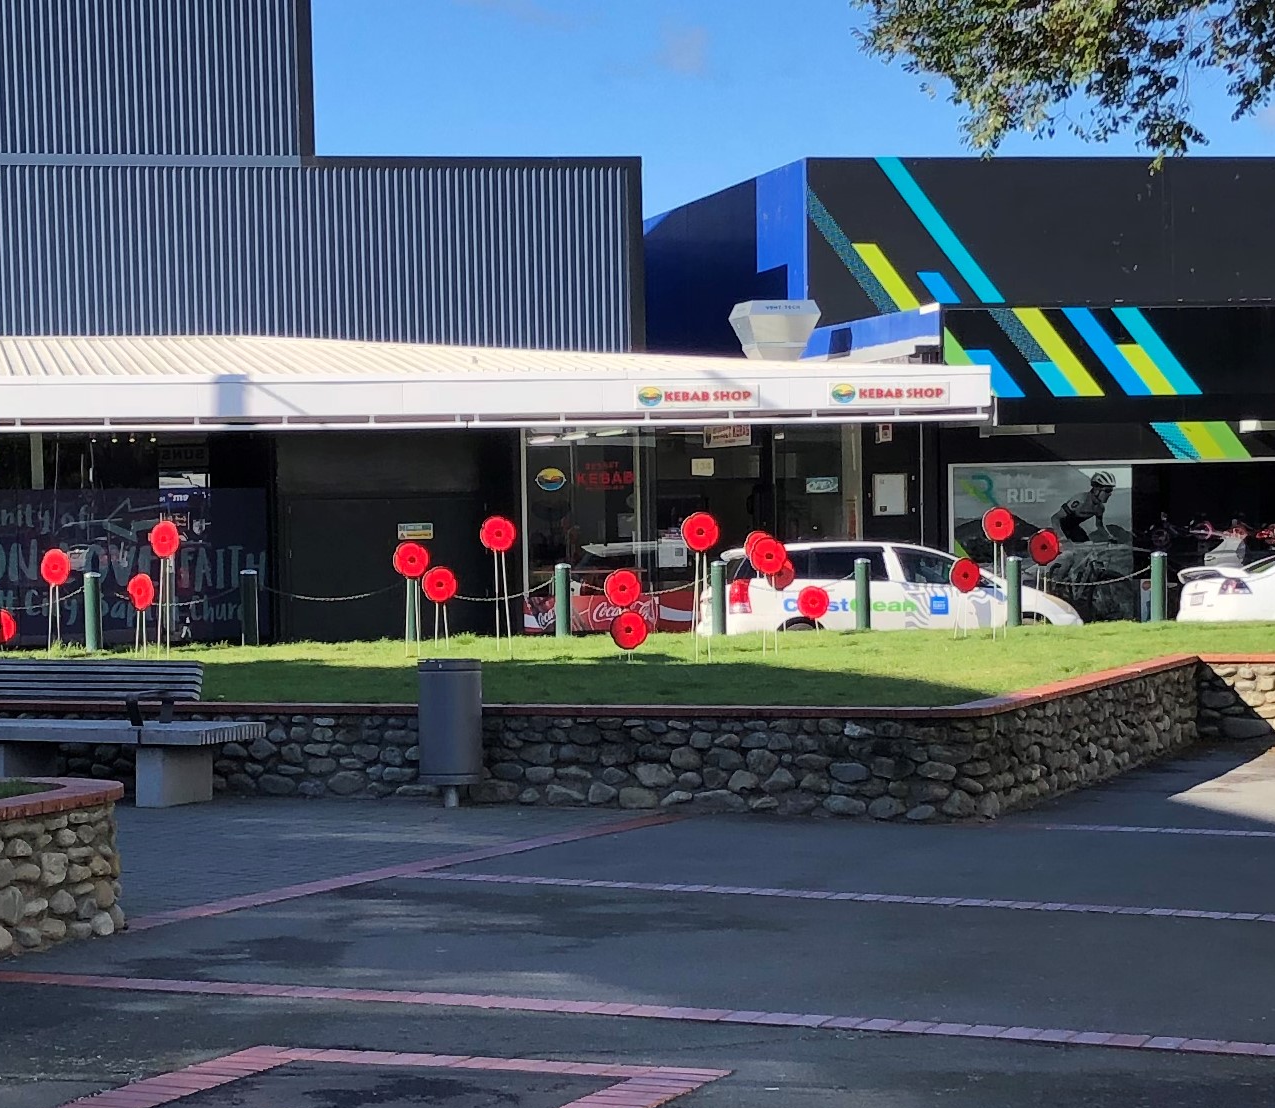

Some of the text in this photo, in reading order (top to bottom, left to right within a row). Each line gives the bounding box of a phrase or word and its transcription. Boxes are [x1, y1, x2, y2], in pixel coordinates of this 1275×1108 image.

[663, 390, 752, 402] KEBAB SHOP
[858, 387, 944, 399] KEBAB SHOP
[1007, 487, 1046, 504] RIDE
